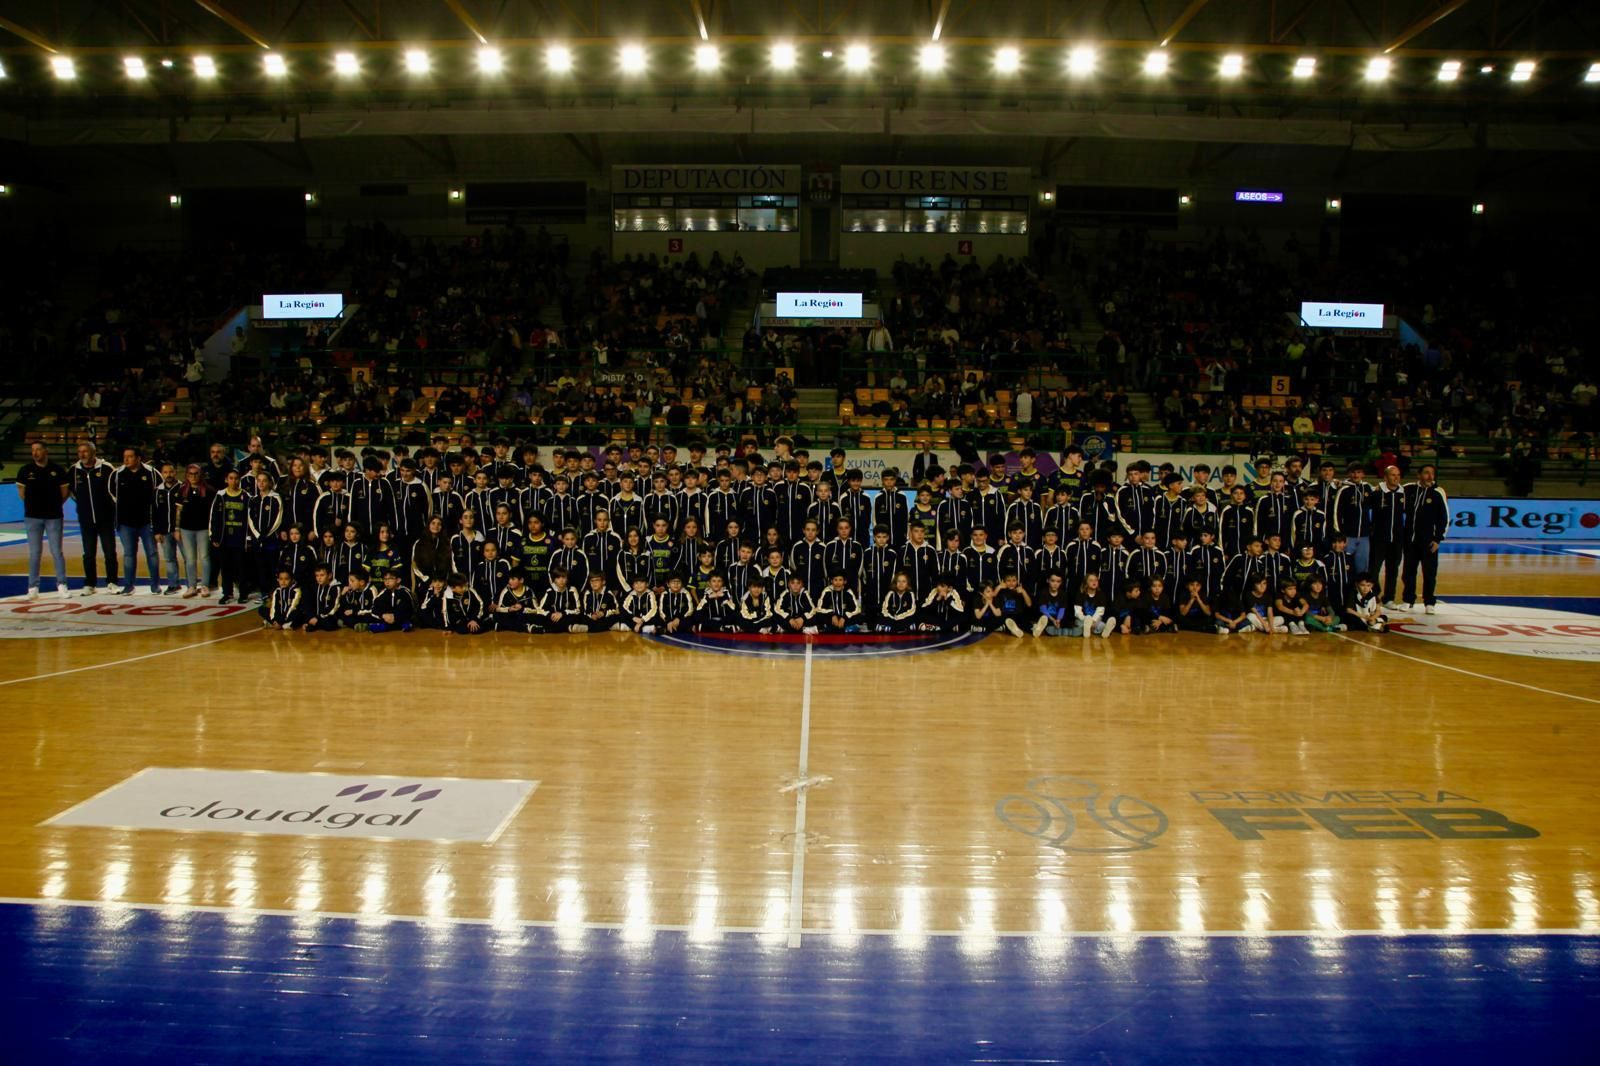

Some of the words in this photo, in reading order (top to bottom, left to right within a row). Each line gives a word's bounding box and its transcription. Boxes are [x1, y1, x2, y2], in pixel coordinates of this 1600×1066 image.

[624, 166, 786, 189] DEPUTACIÓN
[861, 169, 1008, 191] OURENSE
[1238, 191, 1268, 201] ASEOS
[795, 299, 808, 307] La
[1276, 379, 1284, 392] 5
[847, 459, 885, 468] XUNTA
[1189, 790, 1482, 804] PRIMERA
[159, 800, 424, 829] cloud.gal
[1208, 808, 1540, 841] FEB
